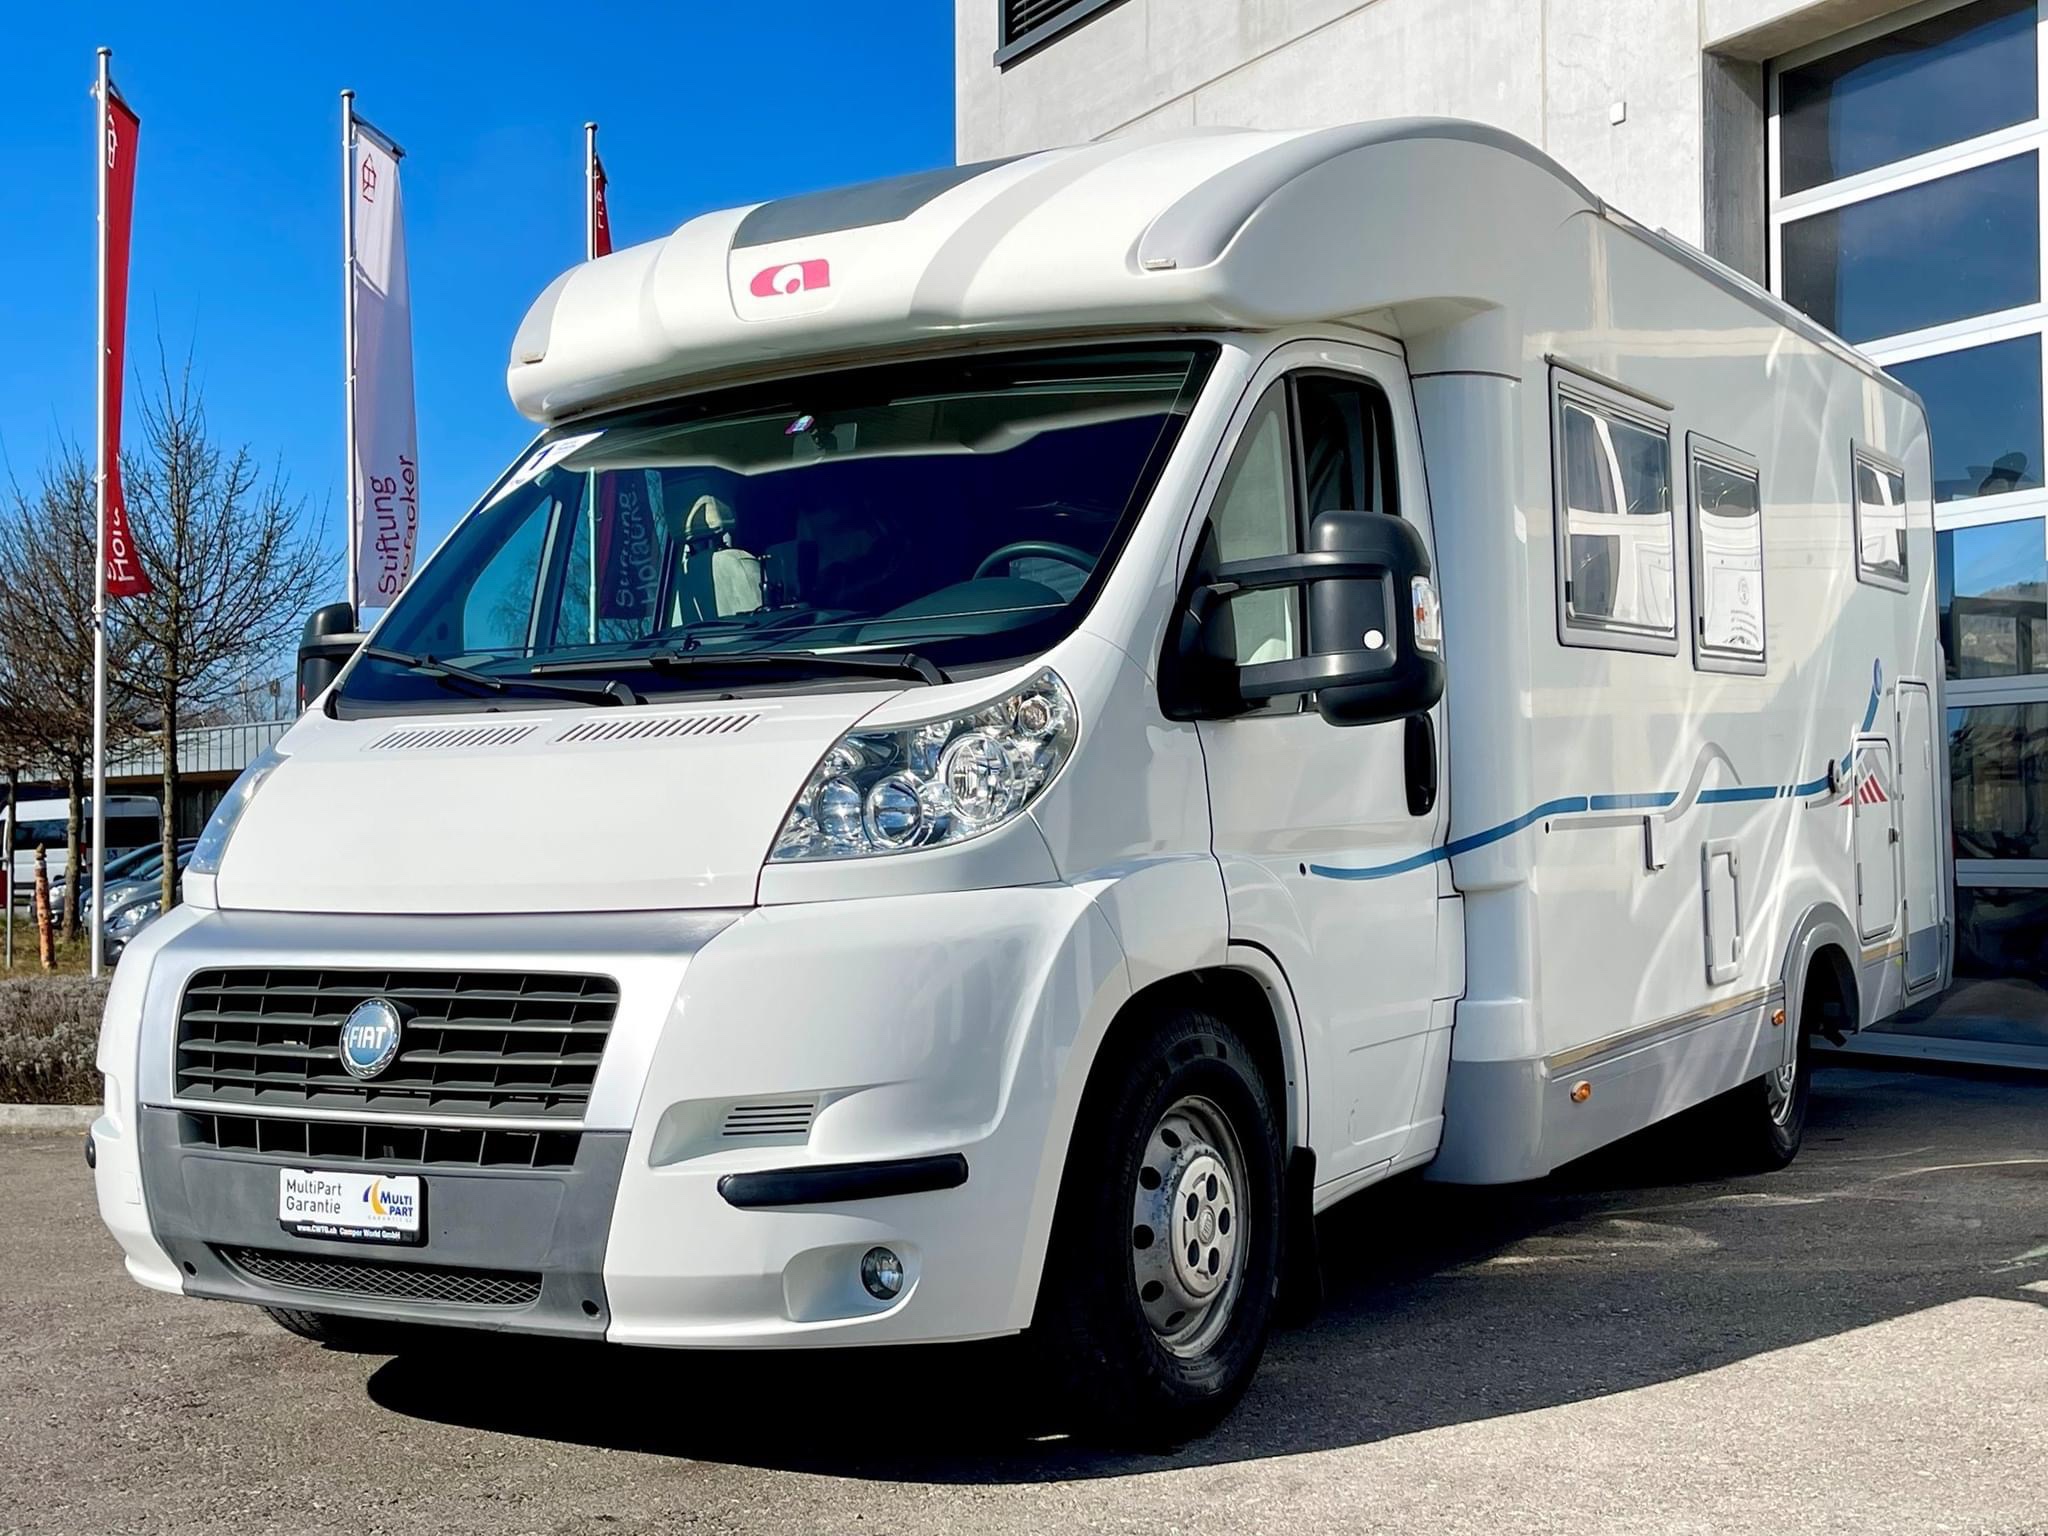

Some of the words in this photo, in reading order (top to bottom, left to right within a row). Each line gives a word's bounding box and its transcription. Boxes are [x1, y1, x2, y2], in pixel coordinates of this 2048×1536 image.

[370, 476, 399, 595] Stiftung
[349, 1026, 387, 1049] FIAT
[286, 1179, 342, 1196] MultiPart
[286, 1196, 341, 1214] Garantie
[380, 1191, 412, 1205] MULTI
[389, 1206, 413, 1217] PART
